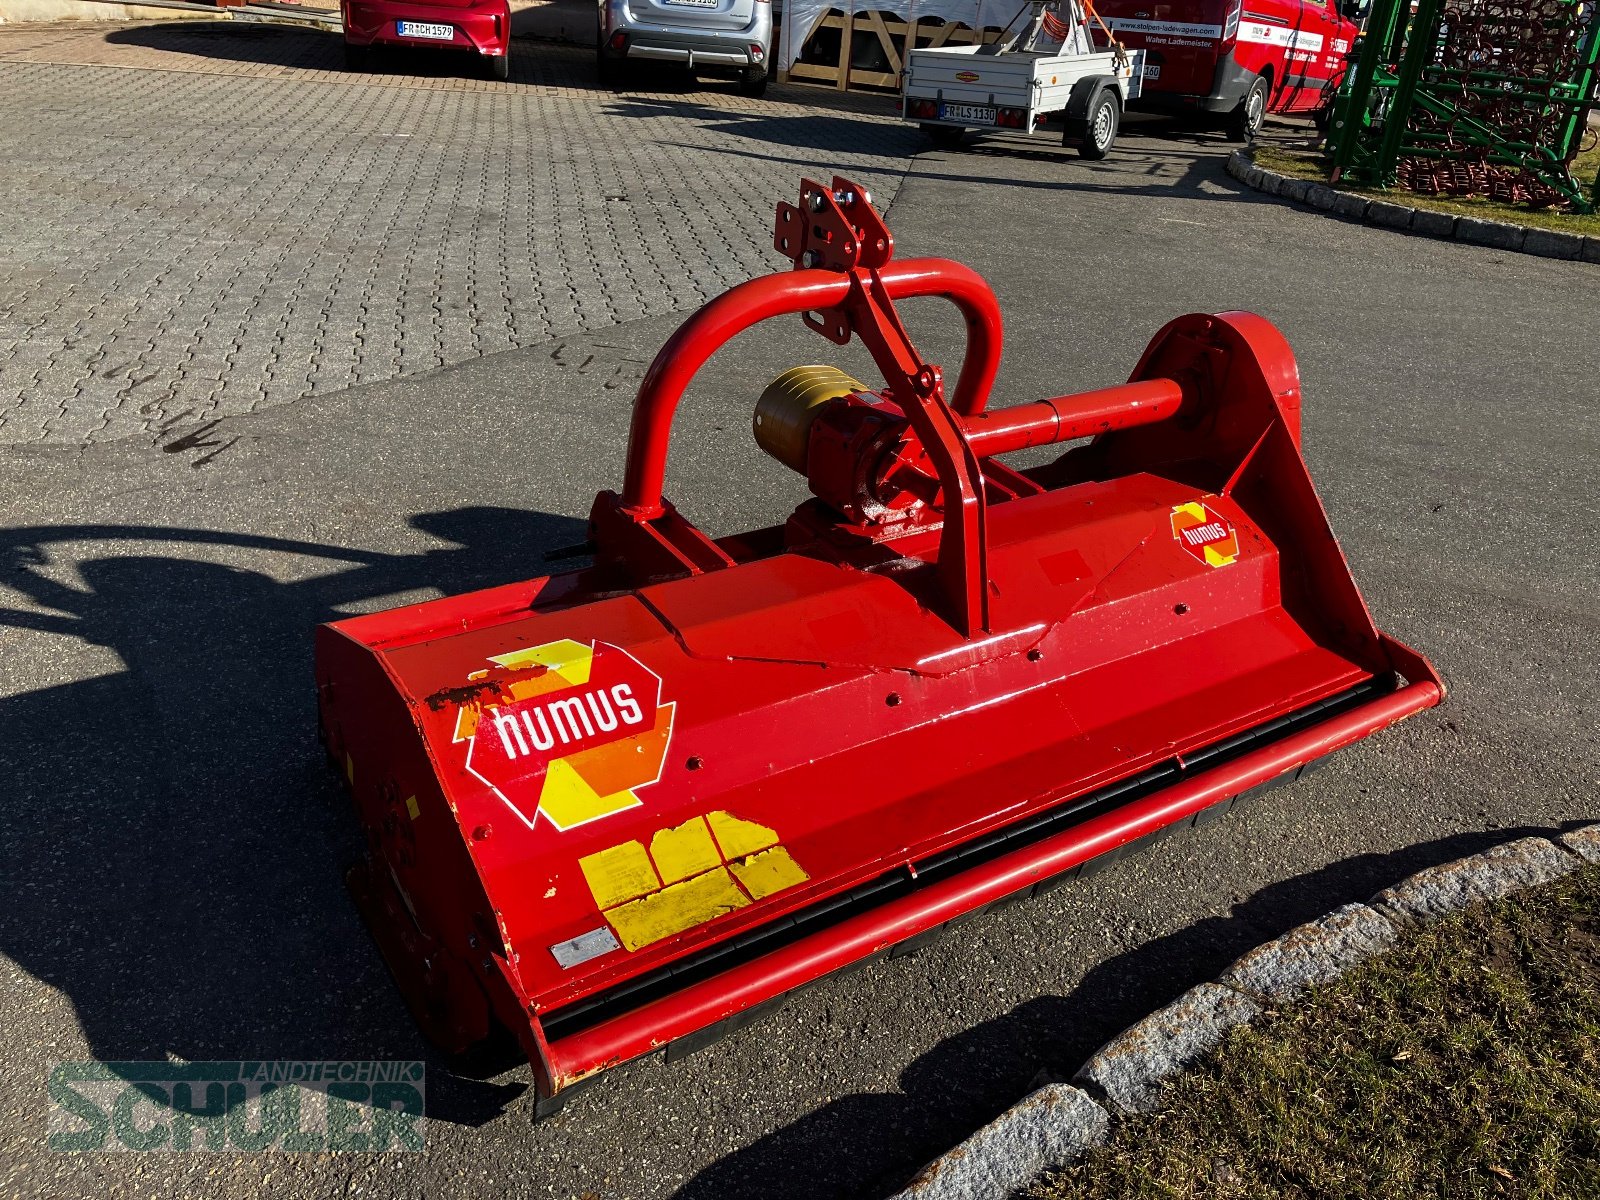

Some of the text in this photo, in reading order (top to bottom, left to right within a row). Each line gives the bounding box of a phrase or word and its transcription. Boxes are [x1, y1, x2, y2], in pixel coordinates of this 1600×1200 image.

[1119, 21, 1215, 35] www.stolpen-ladewagen.com
[1145, 35, 1213, 48] Wahre Lademeister.
[944, 105, 955, 117] FR
[973, 108, 995, 120] 1130
[1181, 522, 1227, 546] humus
[492, 683, 643, 760] humus
